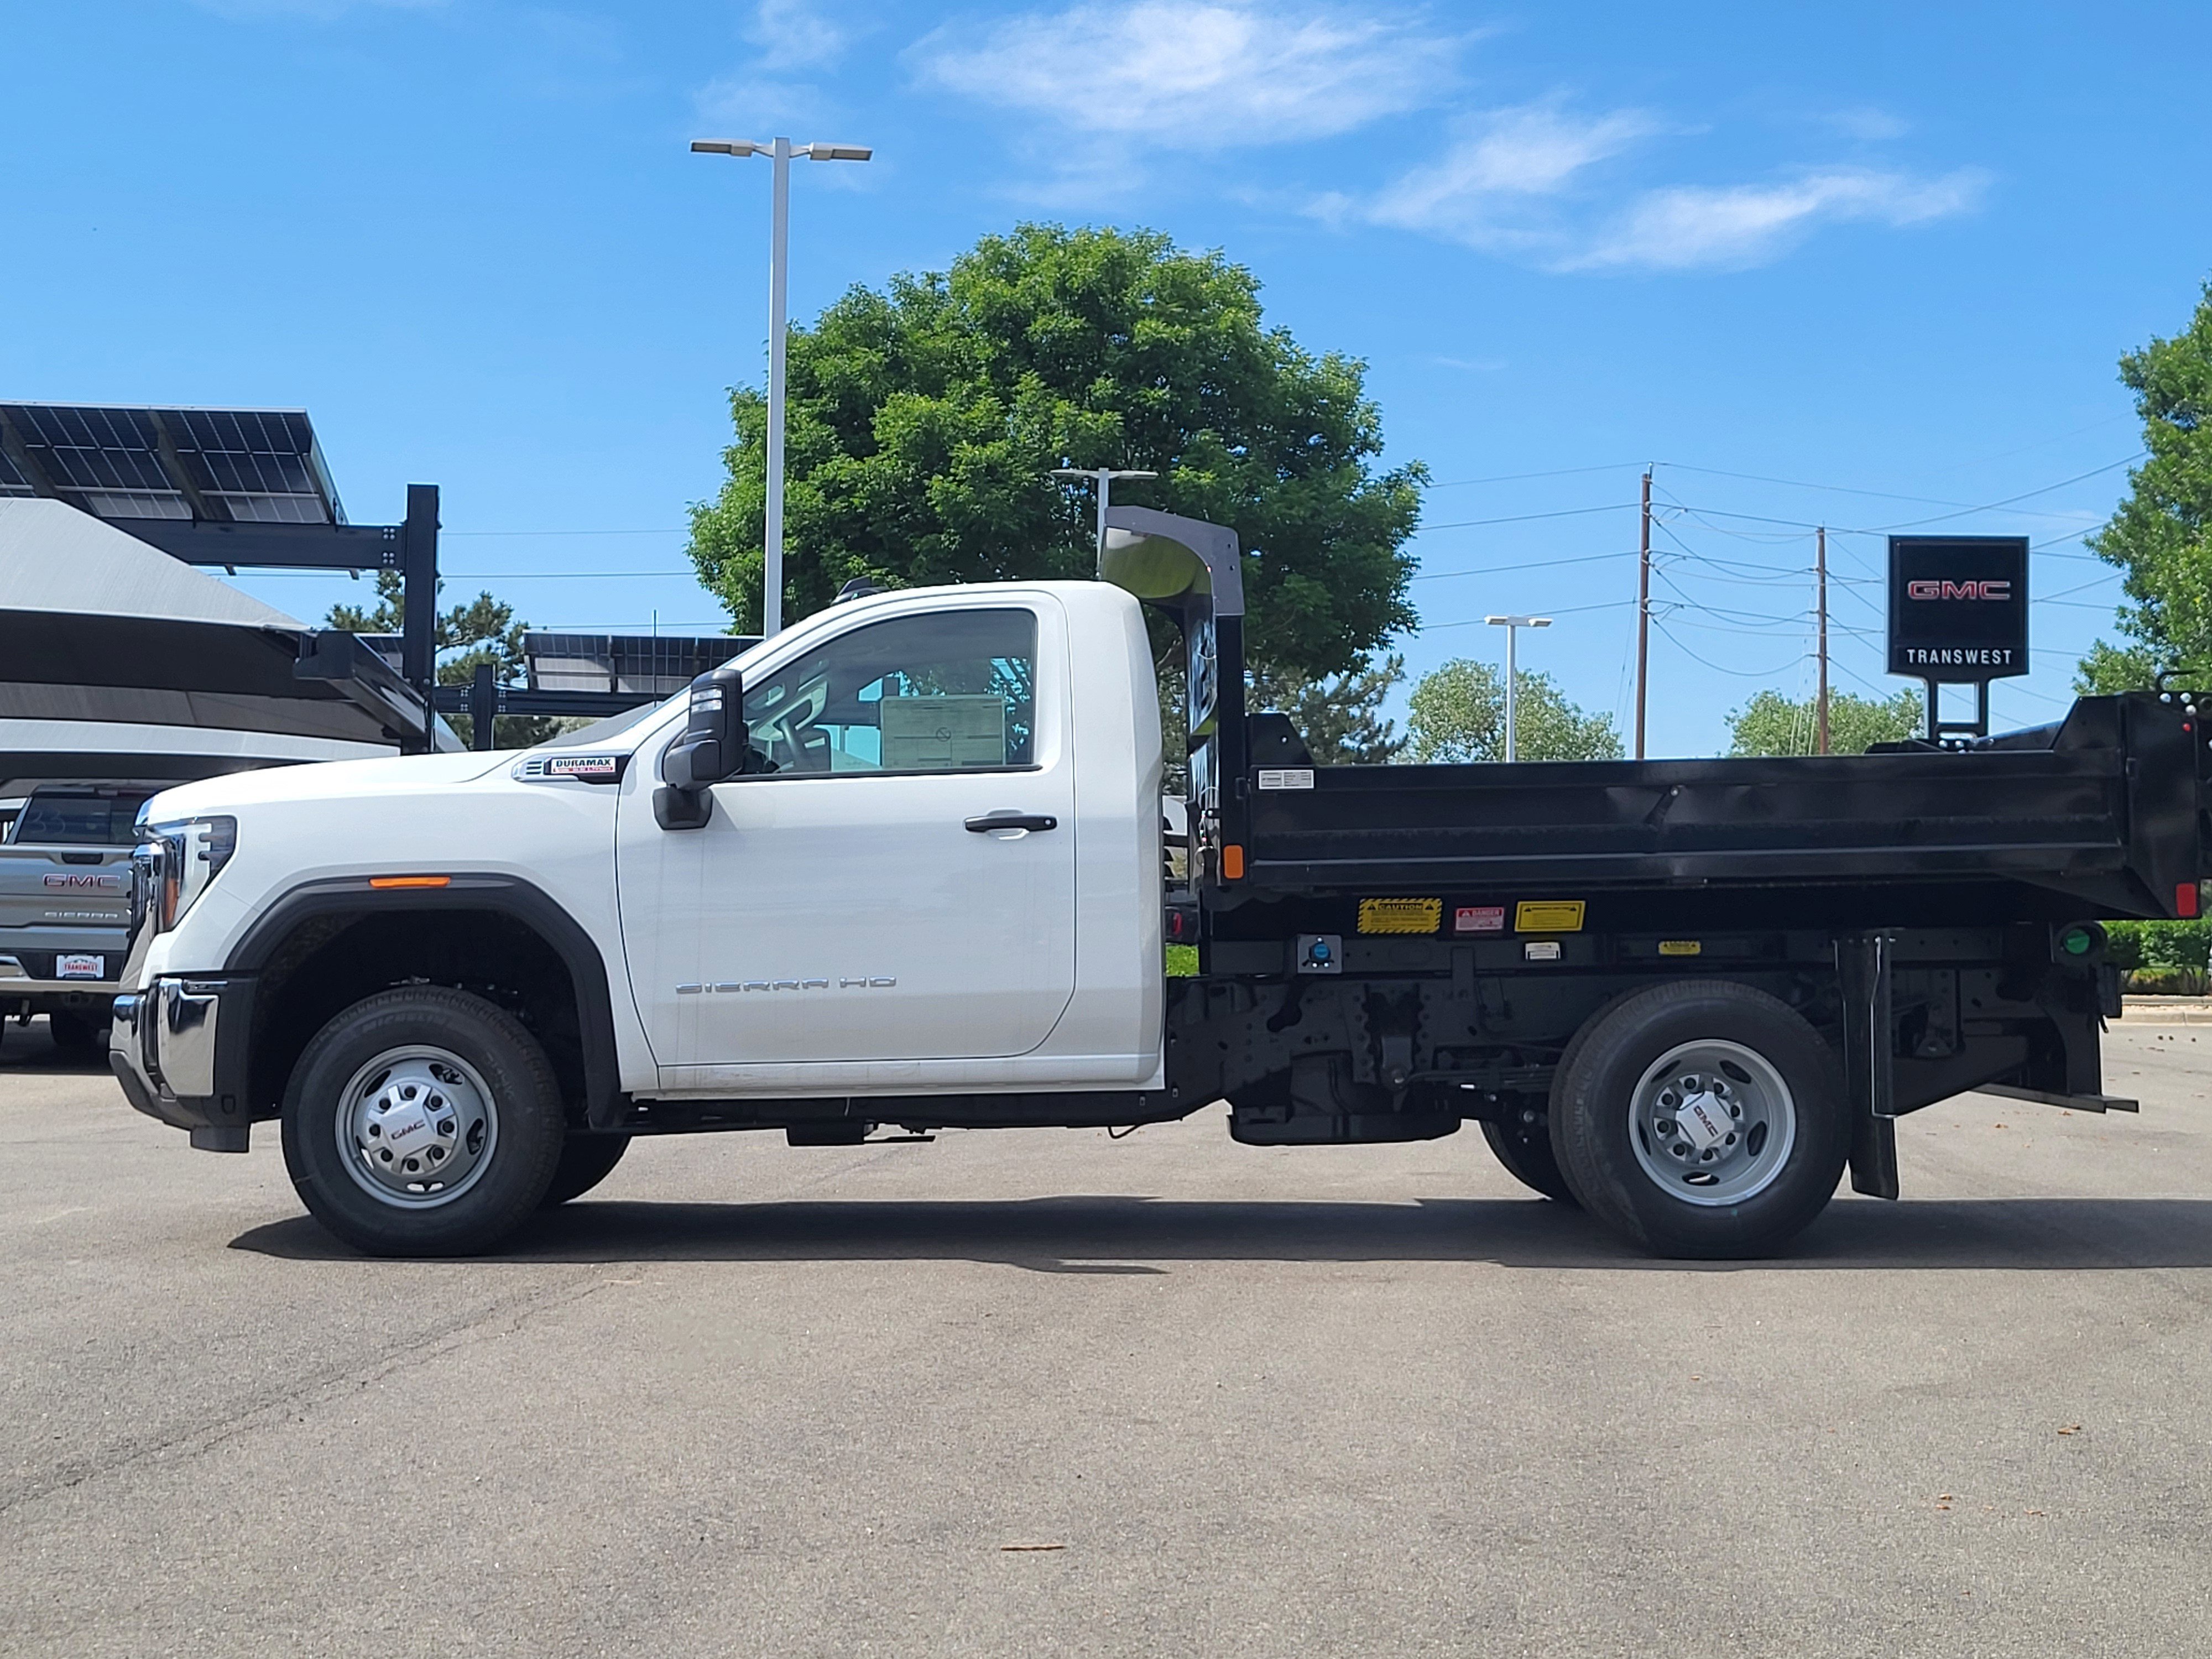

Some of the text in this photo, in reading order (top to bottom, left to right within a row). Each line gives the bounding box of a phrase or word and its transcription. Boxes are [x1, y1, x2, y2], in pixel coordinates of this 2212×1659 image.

[1908, 581, 2011, 600] GMC
[1907, 649, 2011, 664] TRANSWEST
[556, 759, 611, 767] DURAMAX
[43, 874, 120, 888] GMC
[63, 963, 98, 972] TRANSWEST
[676, 976, 896, 994] SIERRA HD
[1693, 1105, 1719, 1137] GMC
[390, 1119, 426, 1140] GMC
